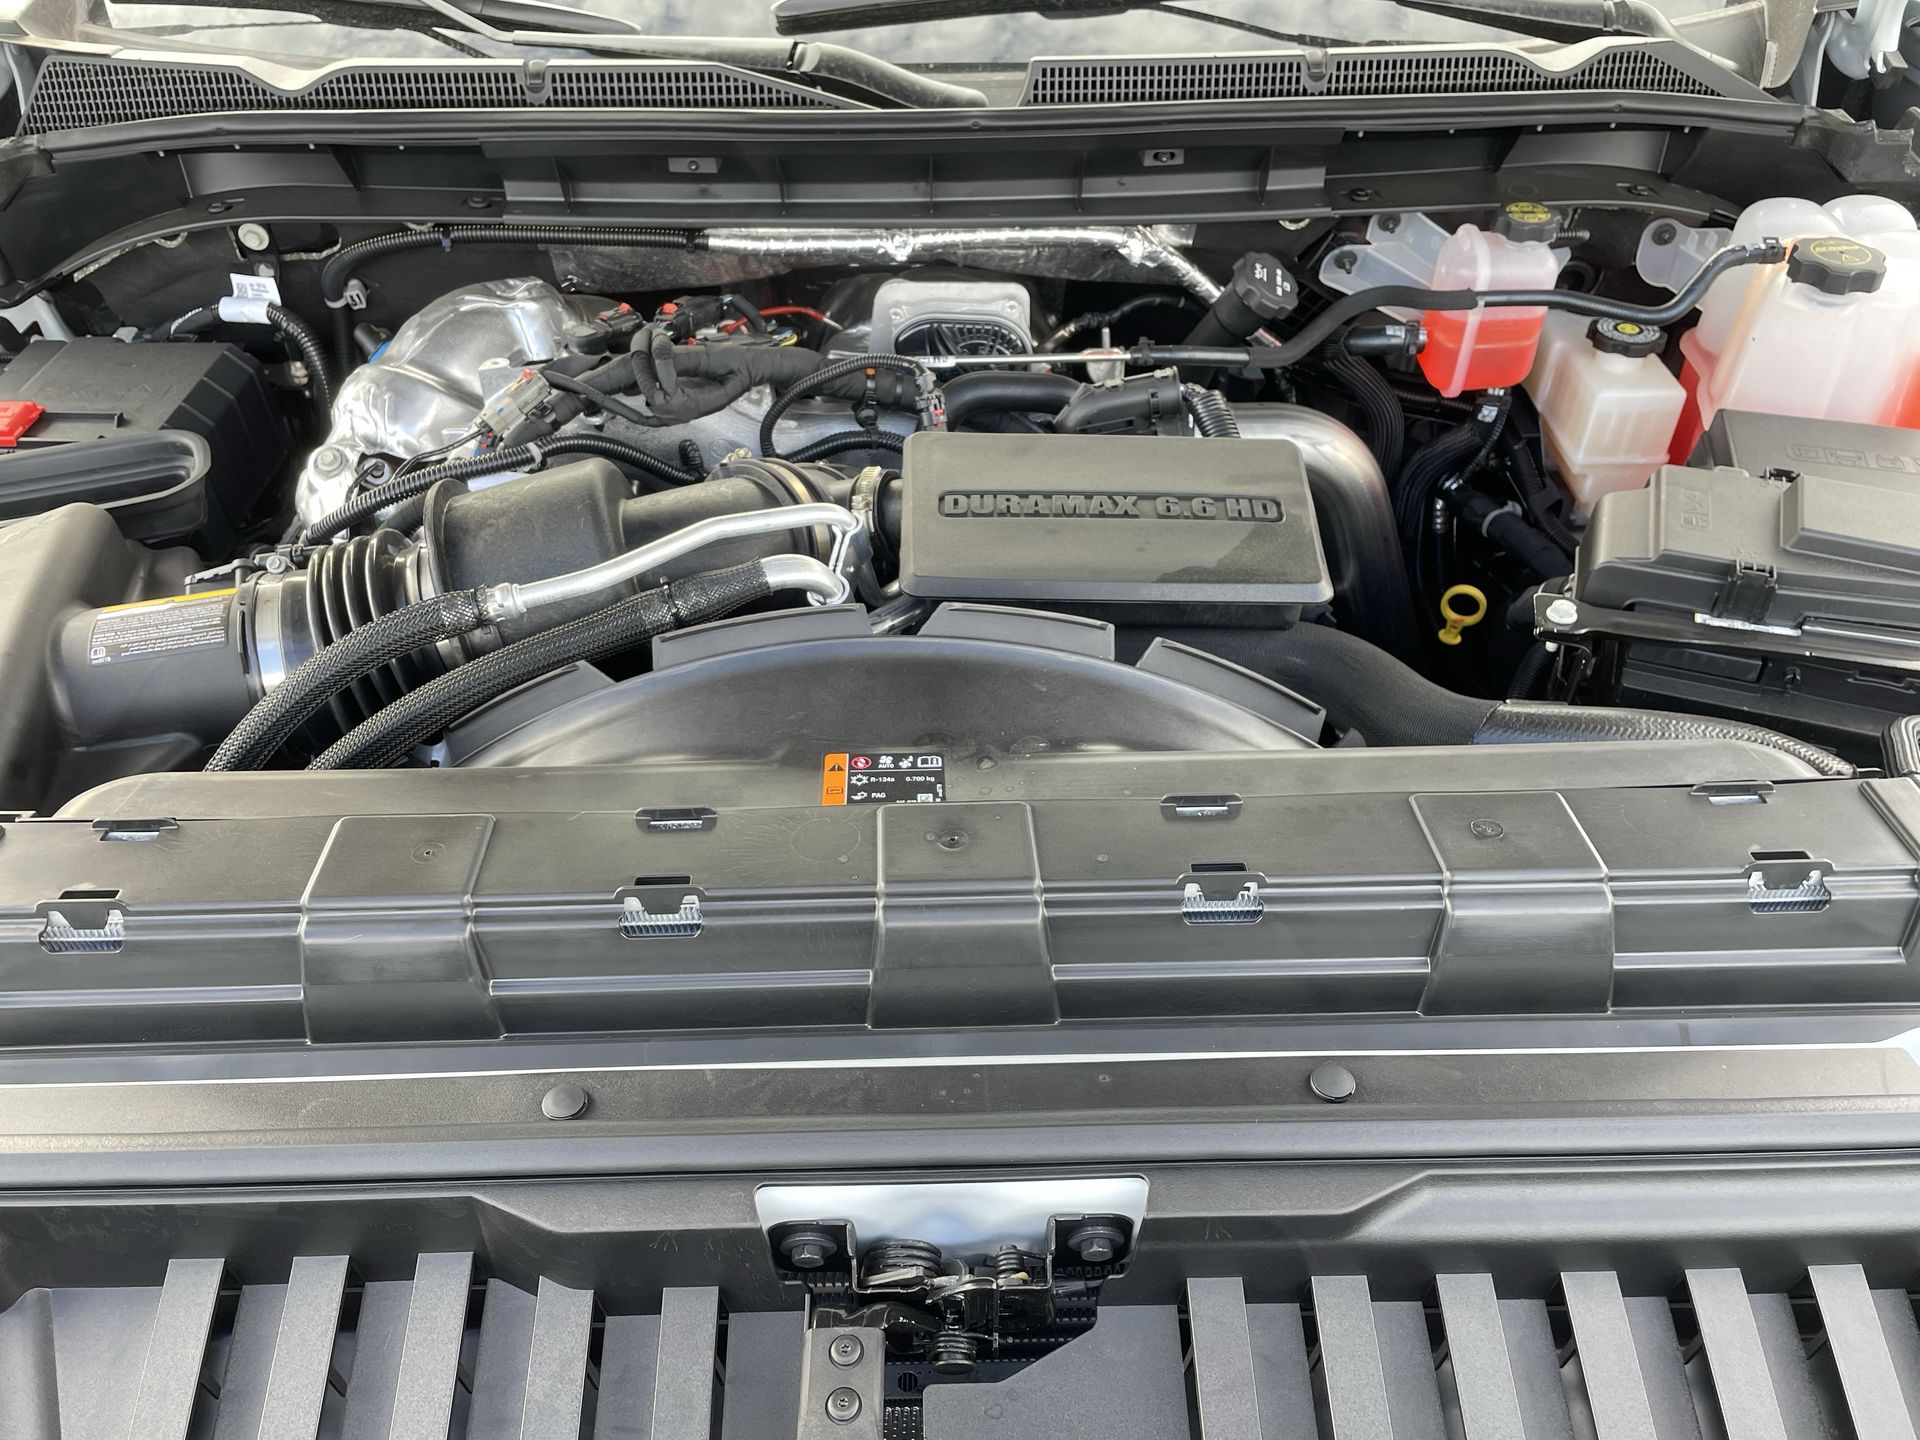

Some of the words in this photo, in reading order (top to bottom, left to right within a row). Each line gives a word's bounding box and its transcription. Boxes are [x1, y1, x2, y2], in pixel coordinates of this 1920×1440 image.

[943, 494, 1140, 518] DURAMAX
[1156, 496, 1216, 518] 6.6
[1227, 497, 1278, 520] HD
